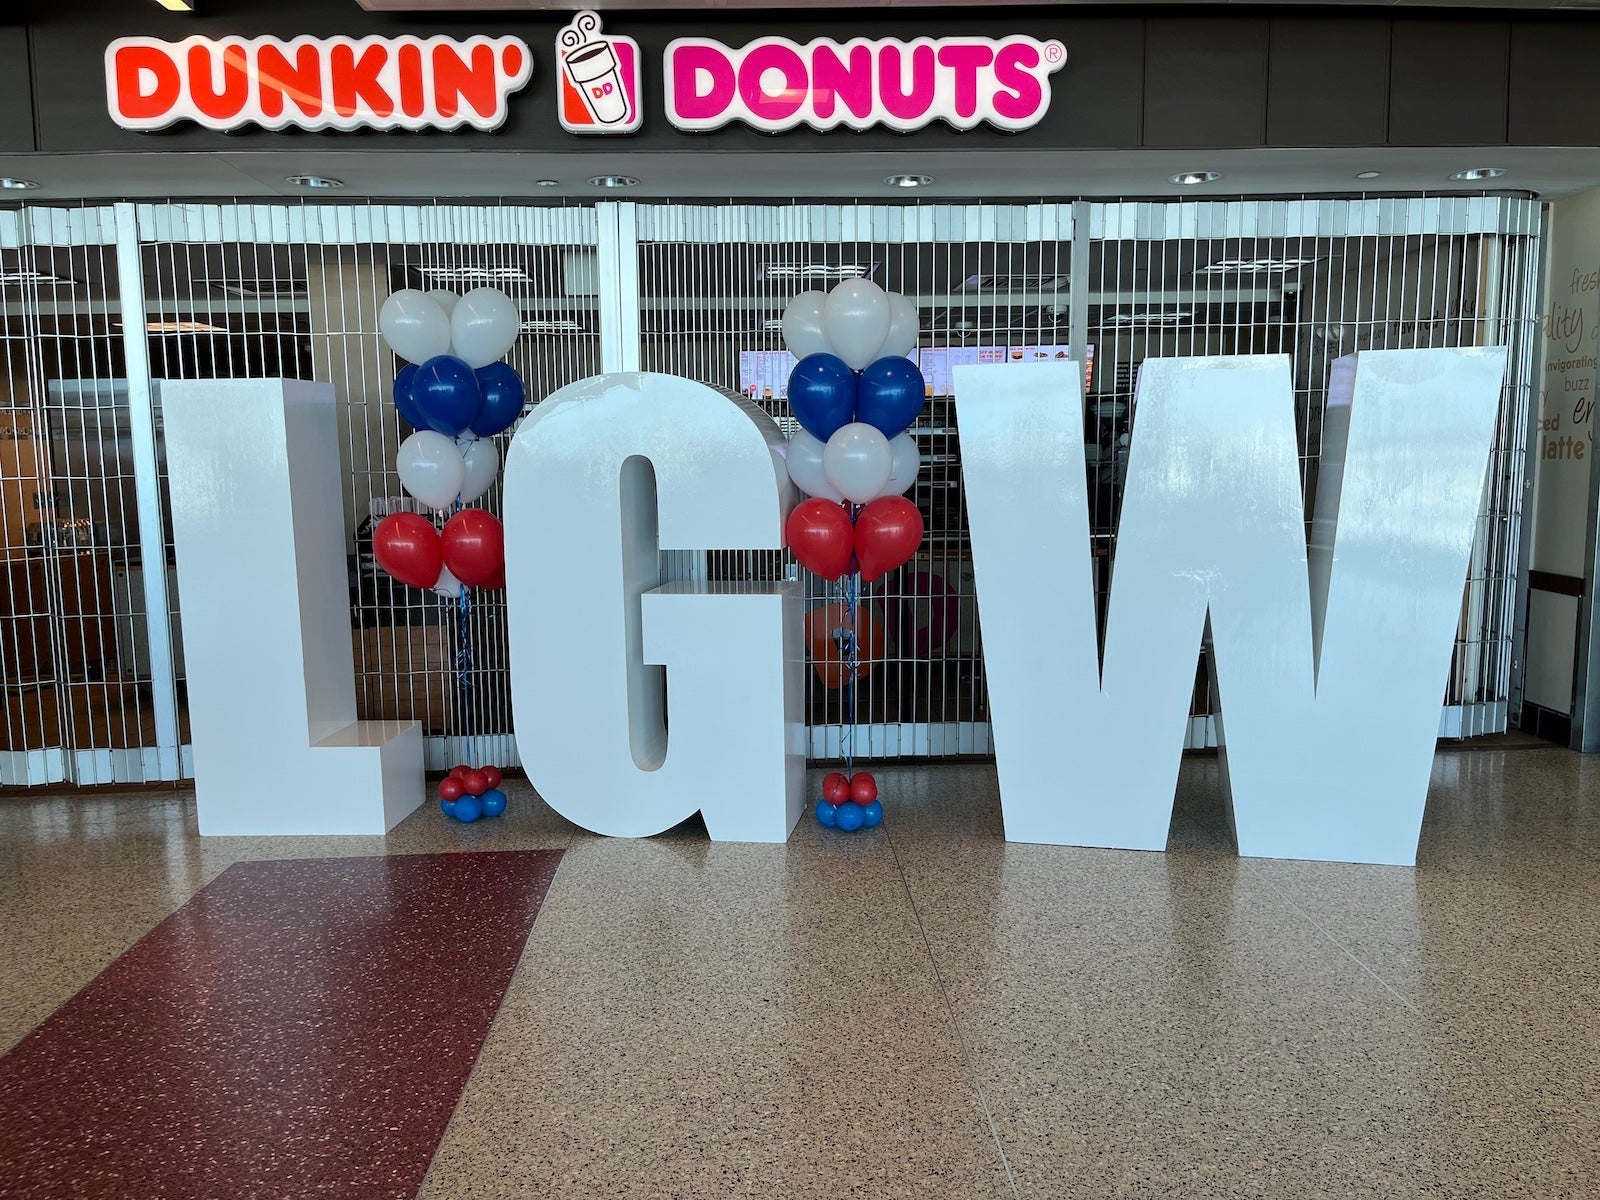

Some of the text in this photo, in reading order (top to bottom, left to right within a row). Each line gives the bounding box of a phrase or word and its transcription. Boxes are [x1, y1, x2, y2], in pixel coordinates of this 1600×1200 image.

[116, 44, 523, 119] DUNKIN'
[591, 82, 613, 99] DD
[673, 43, 1042, 120] DONUTS
[1565, 376, 1590, 392] buzz
[1541, 435, 1585, 460] latte
